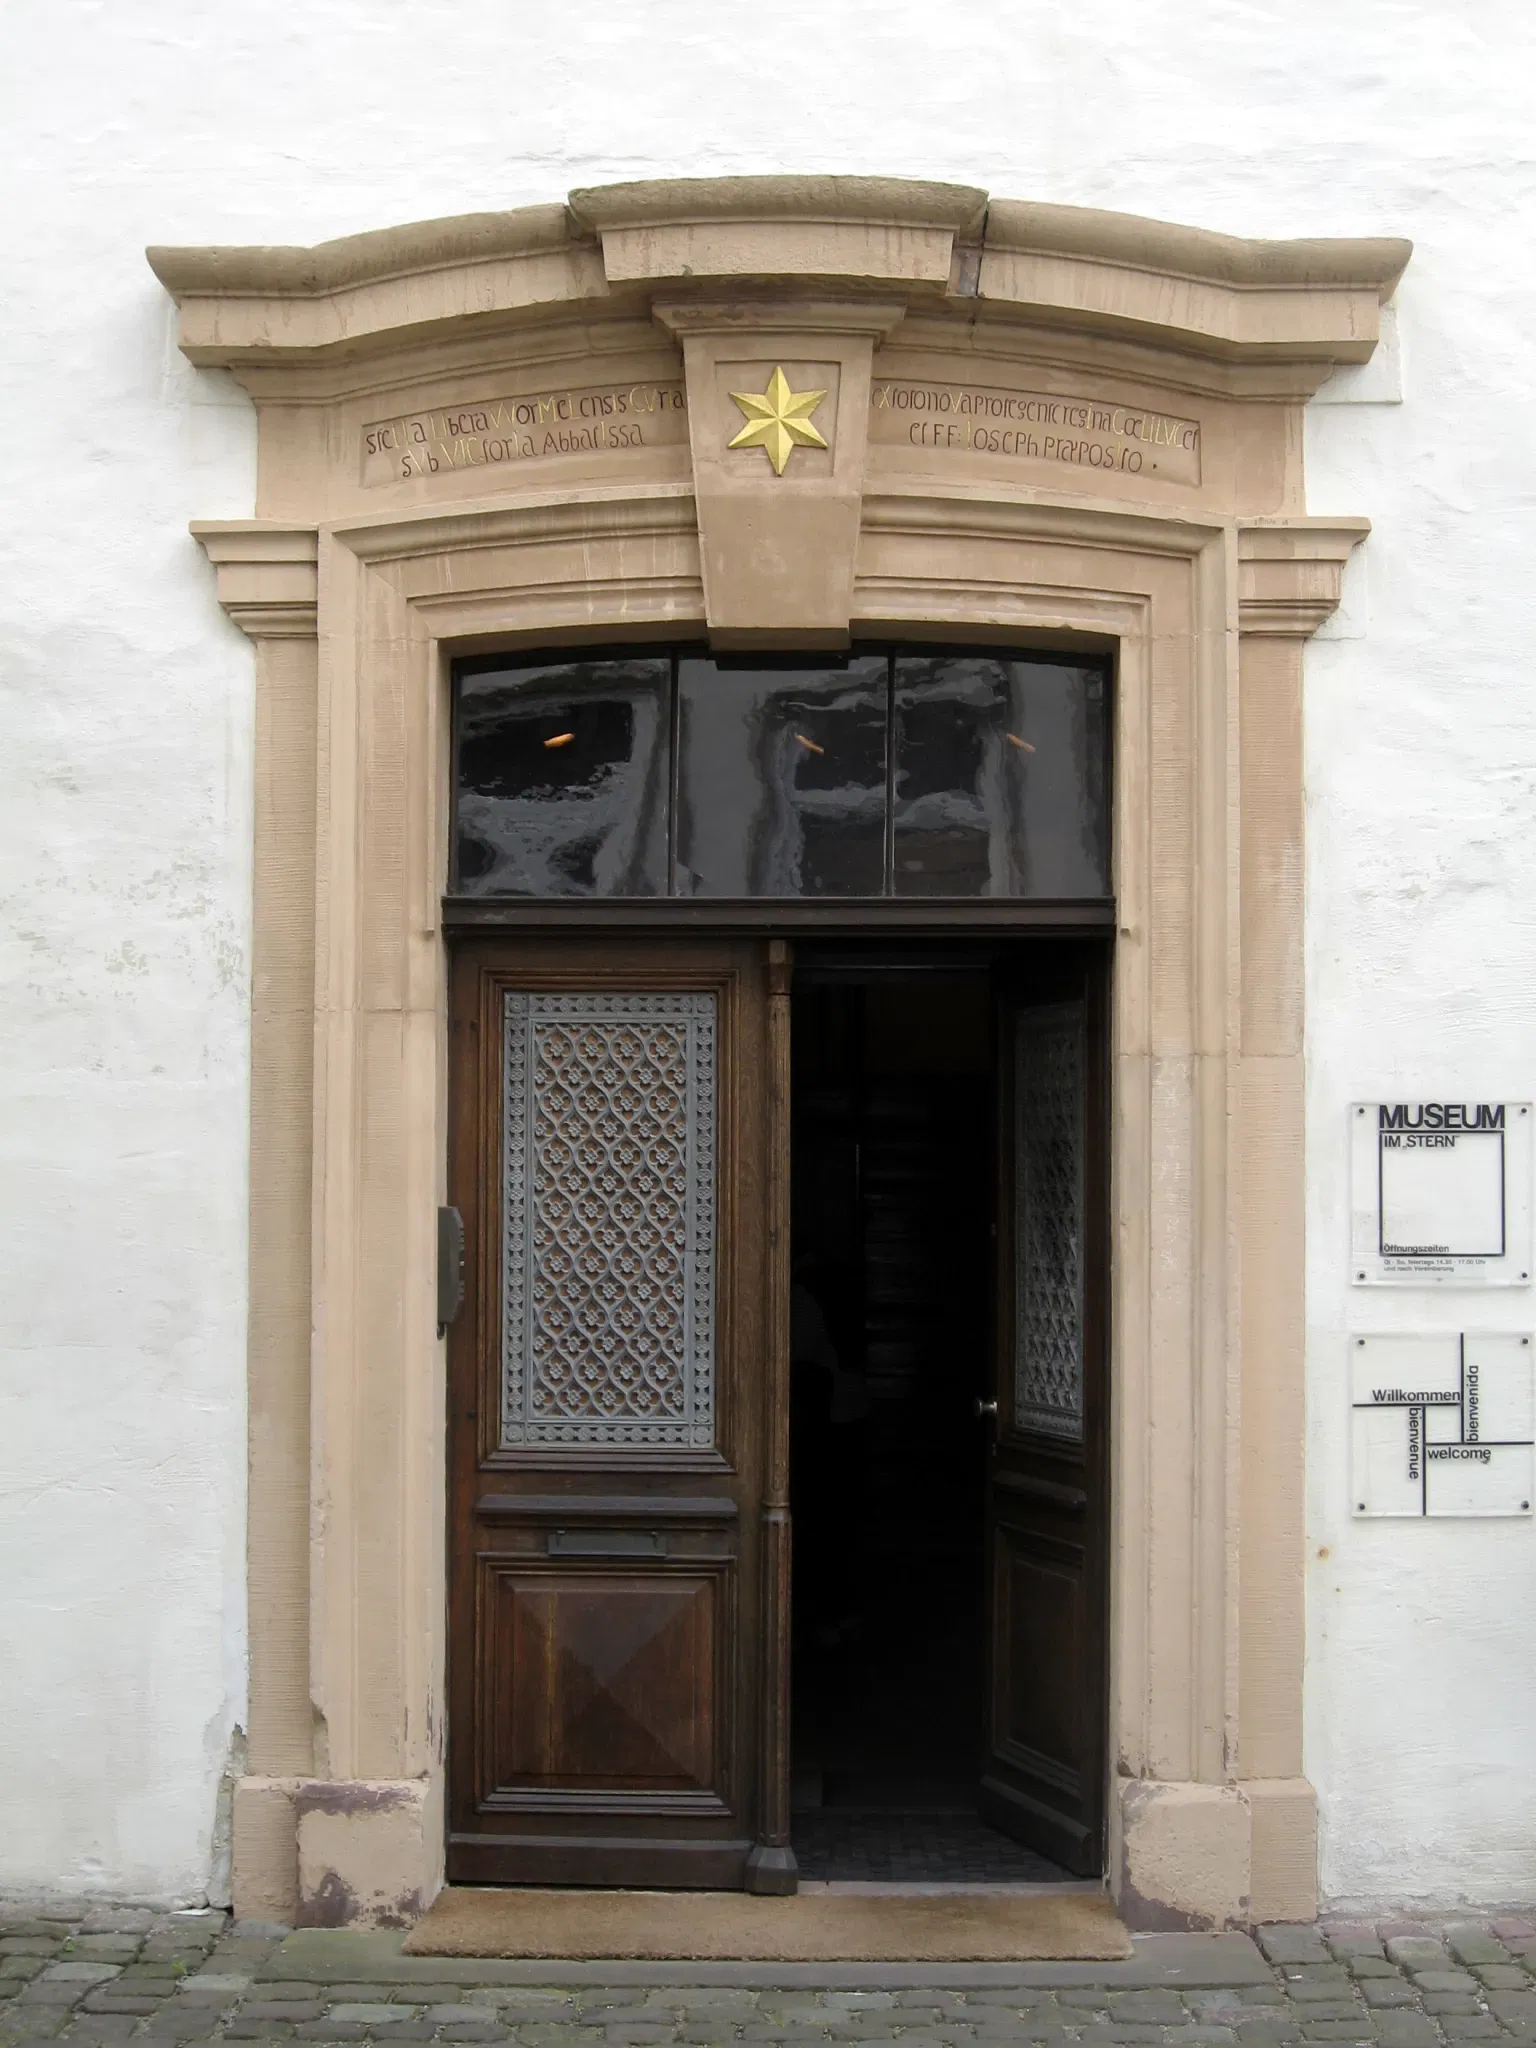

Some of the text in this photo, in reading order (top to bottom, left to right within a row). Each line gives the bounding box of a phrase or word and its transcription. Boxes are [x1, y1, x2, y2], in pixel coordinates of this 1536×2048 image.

[1379, 1103, 1505, 1129] MUSEUM
[1384, 1135, 1401, 1148] IM
[1384, 1243, 1449, 1254] Öffnungszeiten
[1372, 1389, 1461, 1402] Willkommen
[1466, 1365, 1479, 1442] bienvenida
[1409, 1407, 1421, 1479] bienvenue
[1428, 1447, 1491, 1460] welcome
